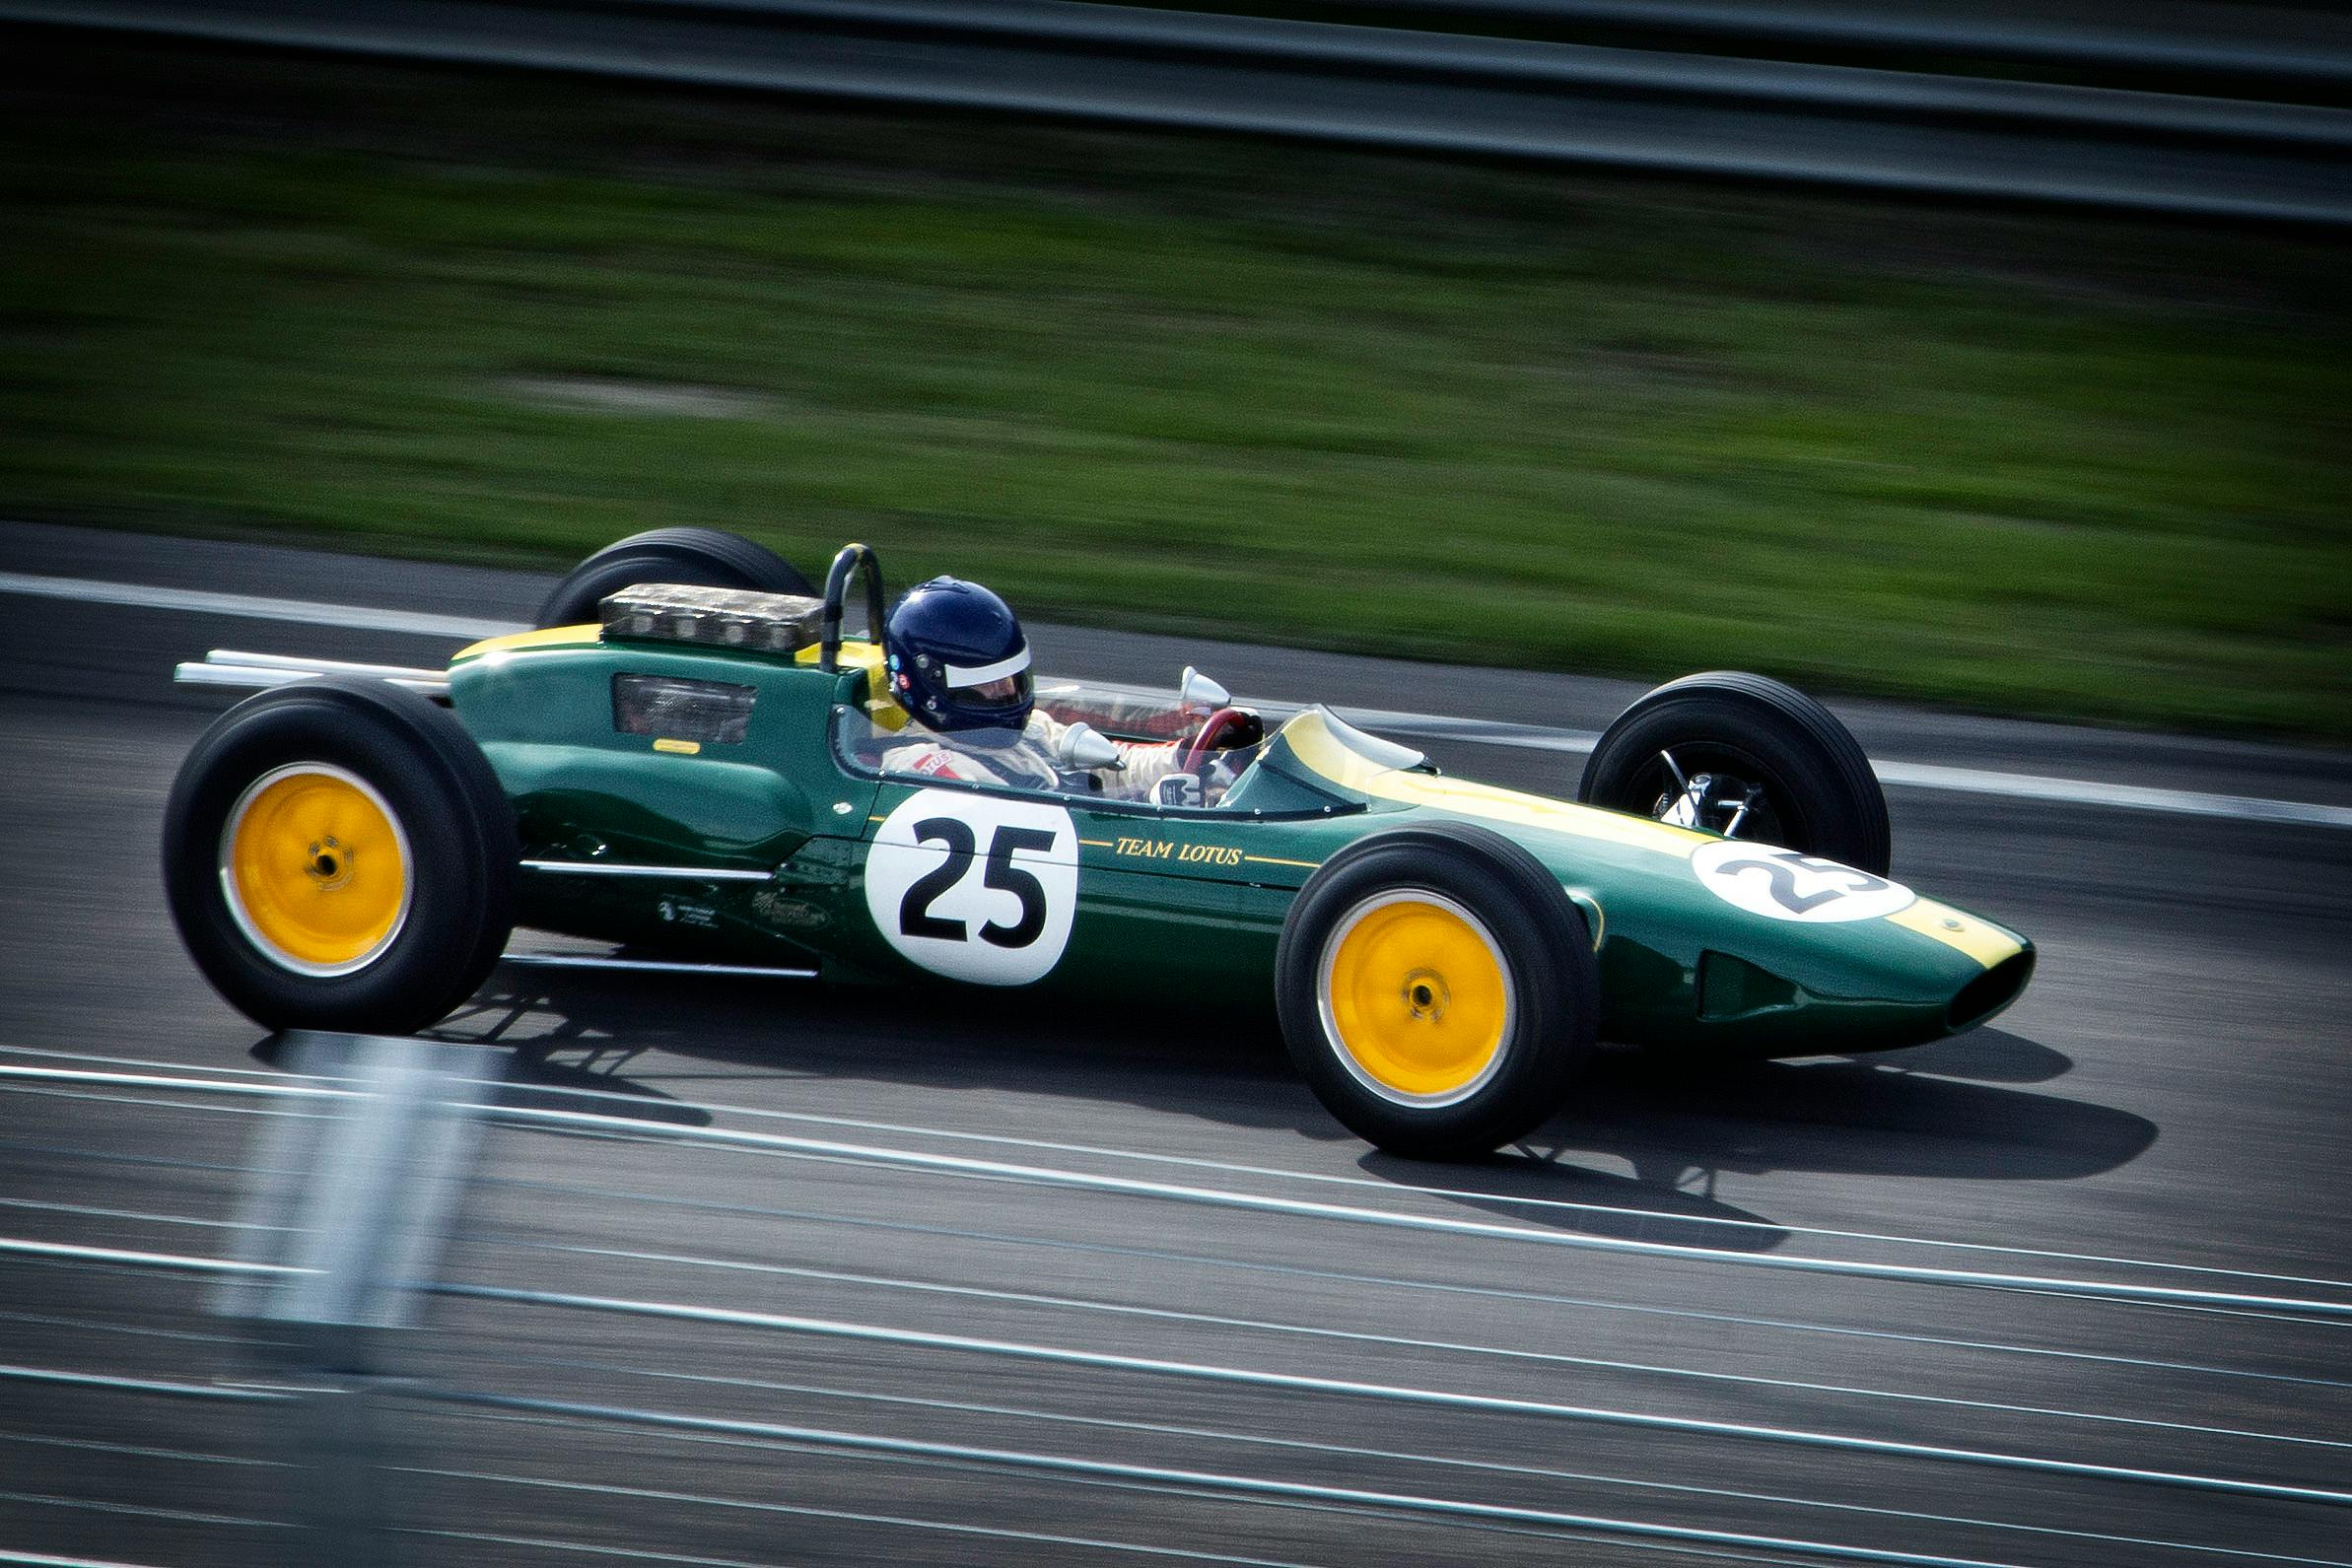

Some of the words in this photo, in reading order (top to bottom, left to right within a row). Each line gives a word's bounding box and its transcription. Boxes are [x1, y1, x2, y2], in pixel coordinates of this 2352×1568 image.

[919, 753, 949, 776] OTUS
[1116, 838, 1174, 858] TEAM
[1178, 844, 1243, 865] LOTUS
[899, 817, 1057, 949] 25
[1715, 852, 1890, 915] 25
